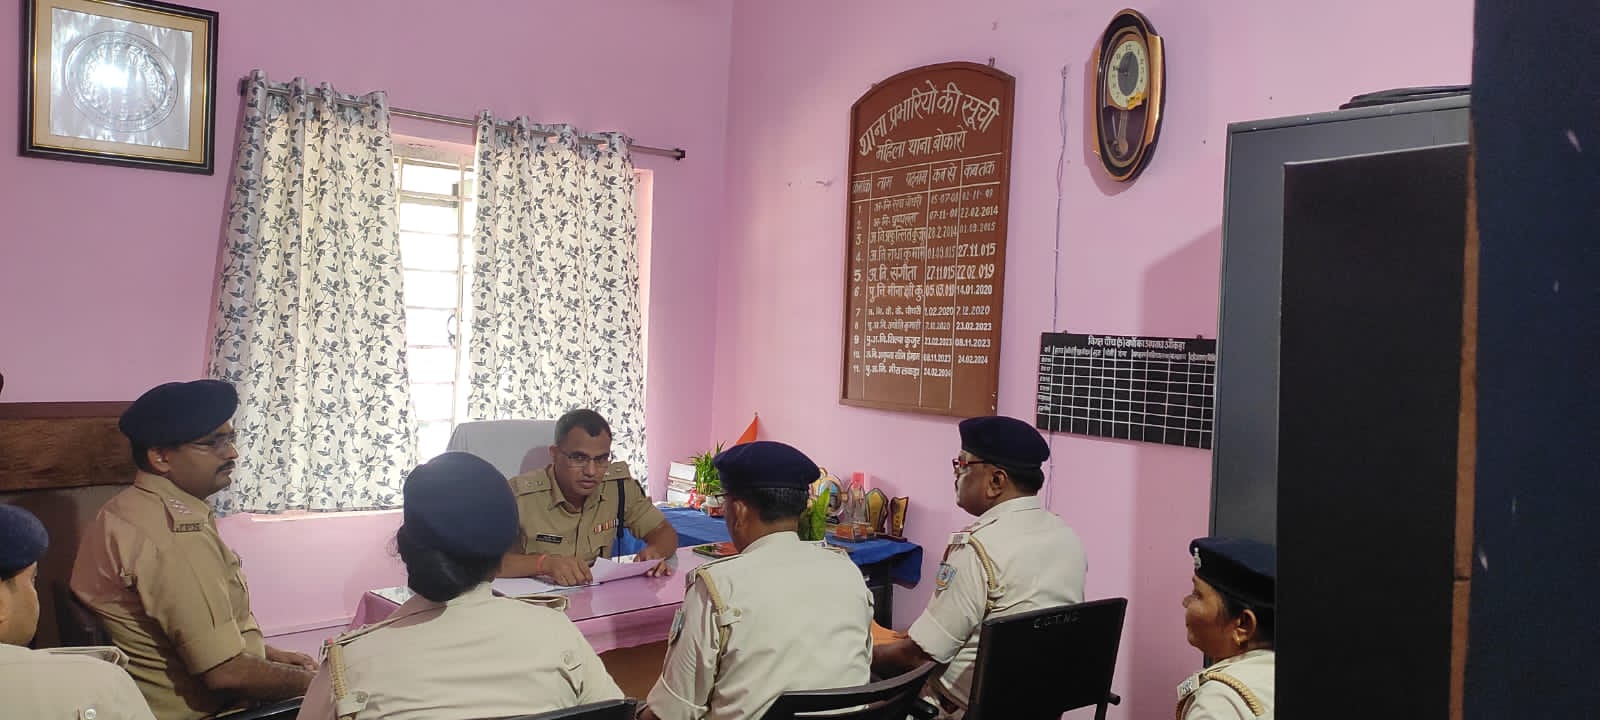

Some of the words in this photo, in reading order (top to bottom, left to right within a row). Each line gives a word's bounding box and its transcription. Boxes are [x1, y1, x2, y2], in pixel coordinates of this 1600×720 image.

[859, 113, 887, 156] थाना
[937, 82, 963, 116] की
[961, 94, 1000, 132] सूची
[875, 139, 905, 163] महिला
[933, 125, 968, 152] बोकारो
[877, 176, 893, 191] नाम
[889, 263, 918, 281] संगीता
[957, 283, 993, 296] 14.01.2020
